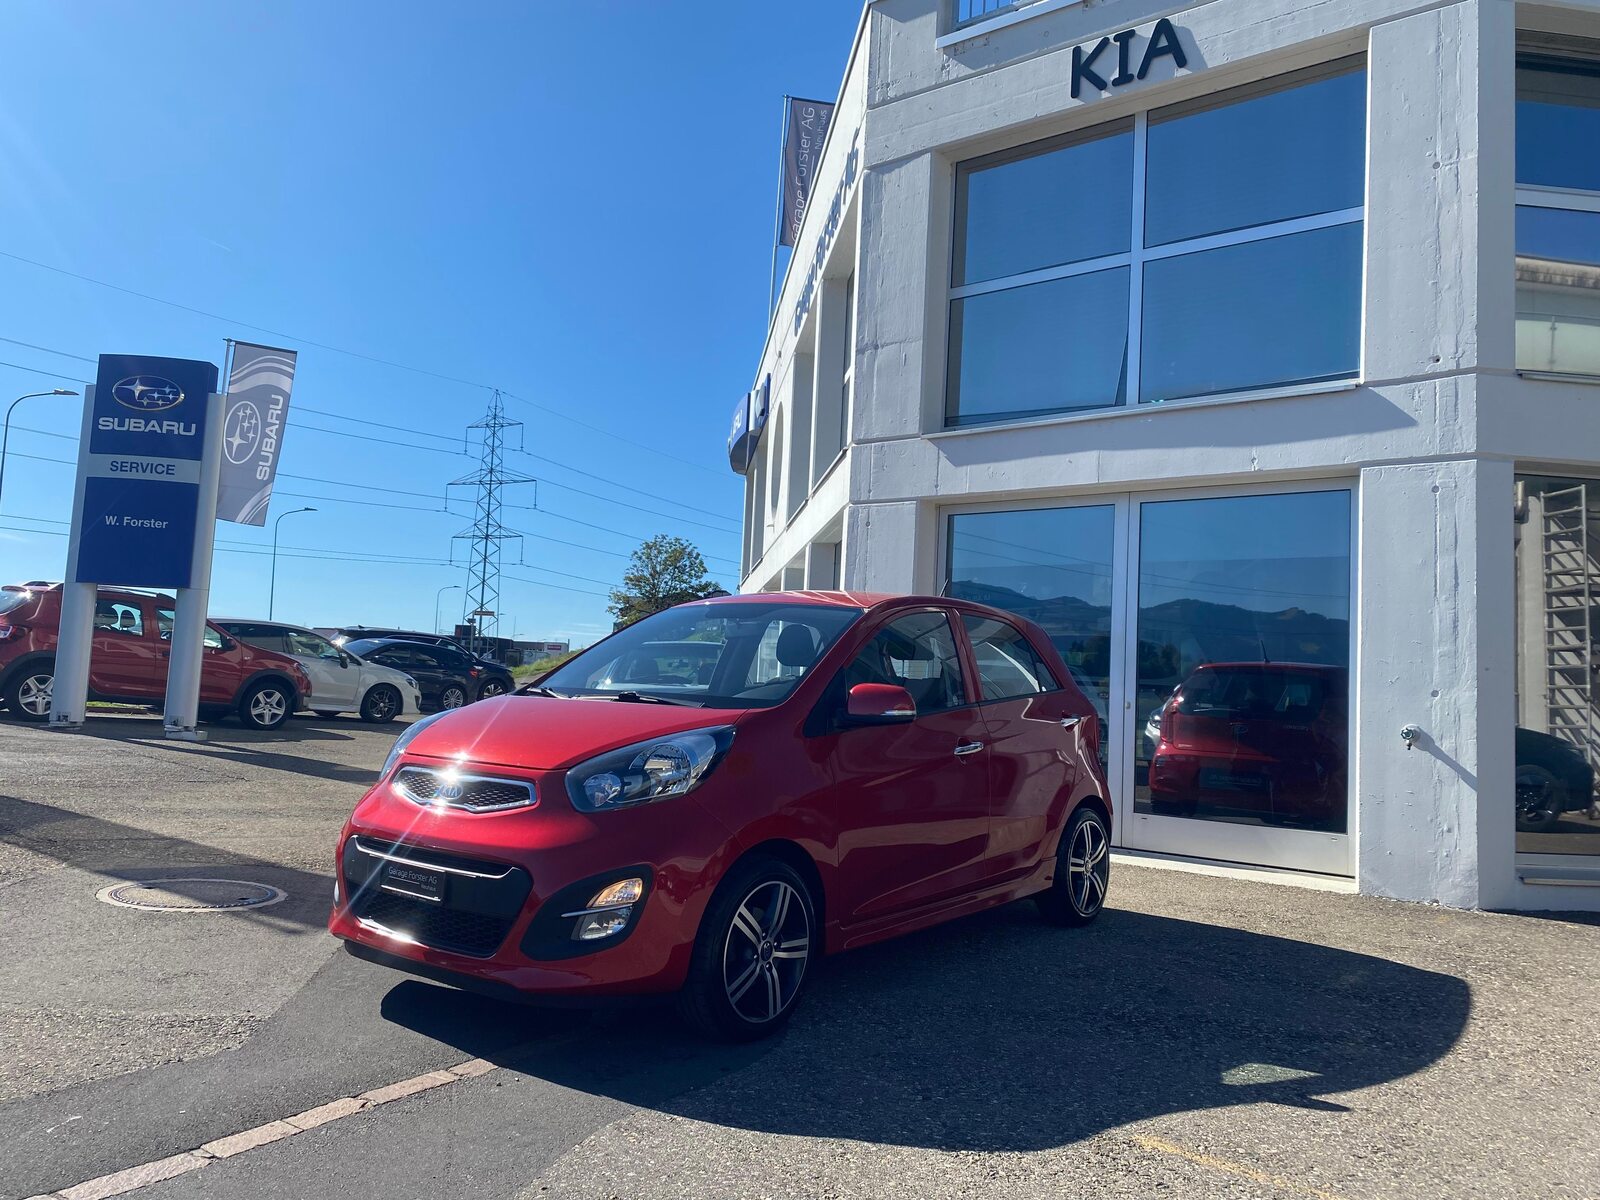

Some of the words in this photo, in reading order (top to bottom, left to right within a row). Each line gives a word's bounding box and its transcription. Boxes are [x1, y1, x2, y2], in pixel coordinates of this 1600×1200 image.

[1071, 17, 1187, 99] KIA
[801, 107, 815, 130] AG
[98, 417, 196, 436] SUBARU
[256, 394, 284, 481] SUBARU
[110, 460, 176, 476] SERVICE
[105, 515, 119, 526] W.
[123, 516, 169, 529] Forster
[389, 867, 408, 878] Garage
[408, 870, 428, 882] Forster
[428, 875, 438, 885] AG
